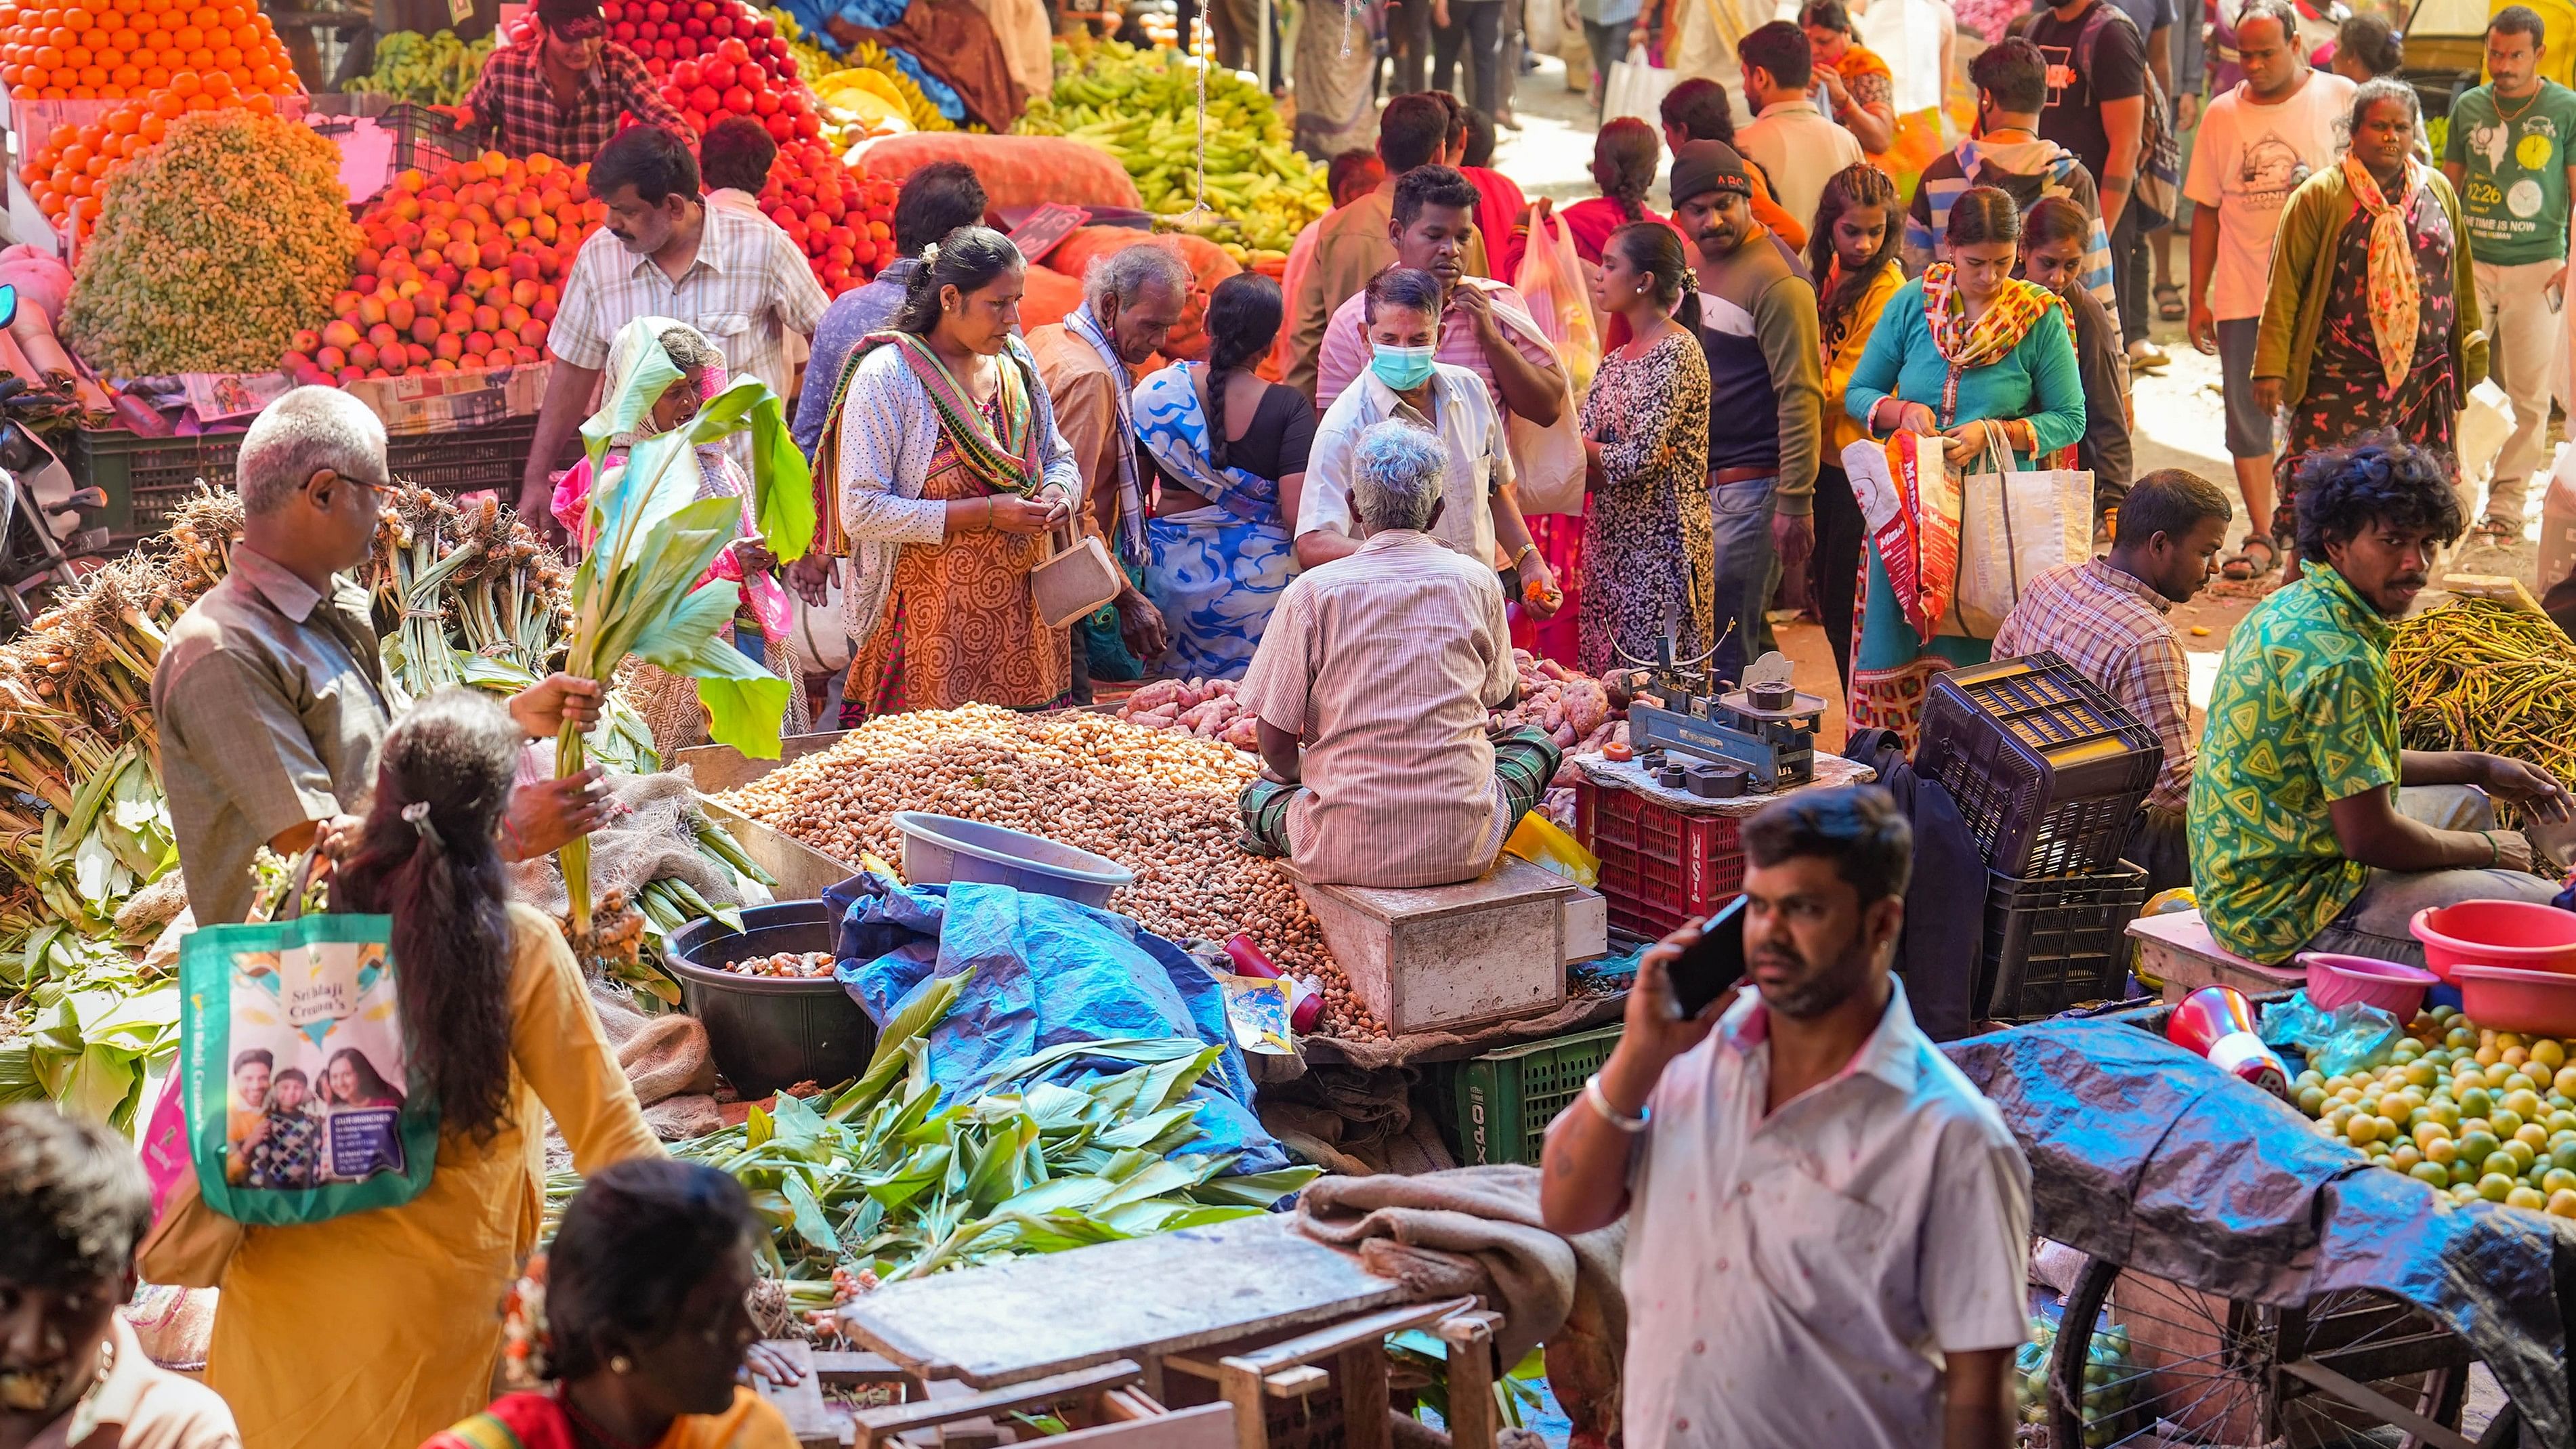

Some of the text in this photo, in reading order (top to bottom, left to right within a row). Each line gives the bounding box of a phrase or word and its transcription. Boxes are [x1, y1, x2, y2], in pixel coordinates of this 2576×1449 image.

[2468, 182, 2502, 204] 12:26
[2475, 217, 2496, 230] TIME
[2497, 220, 2508, 231] IS
[2510, 220, 2536, 232] NOW
